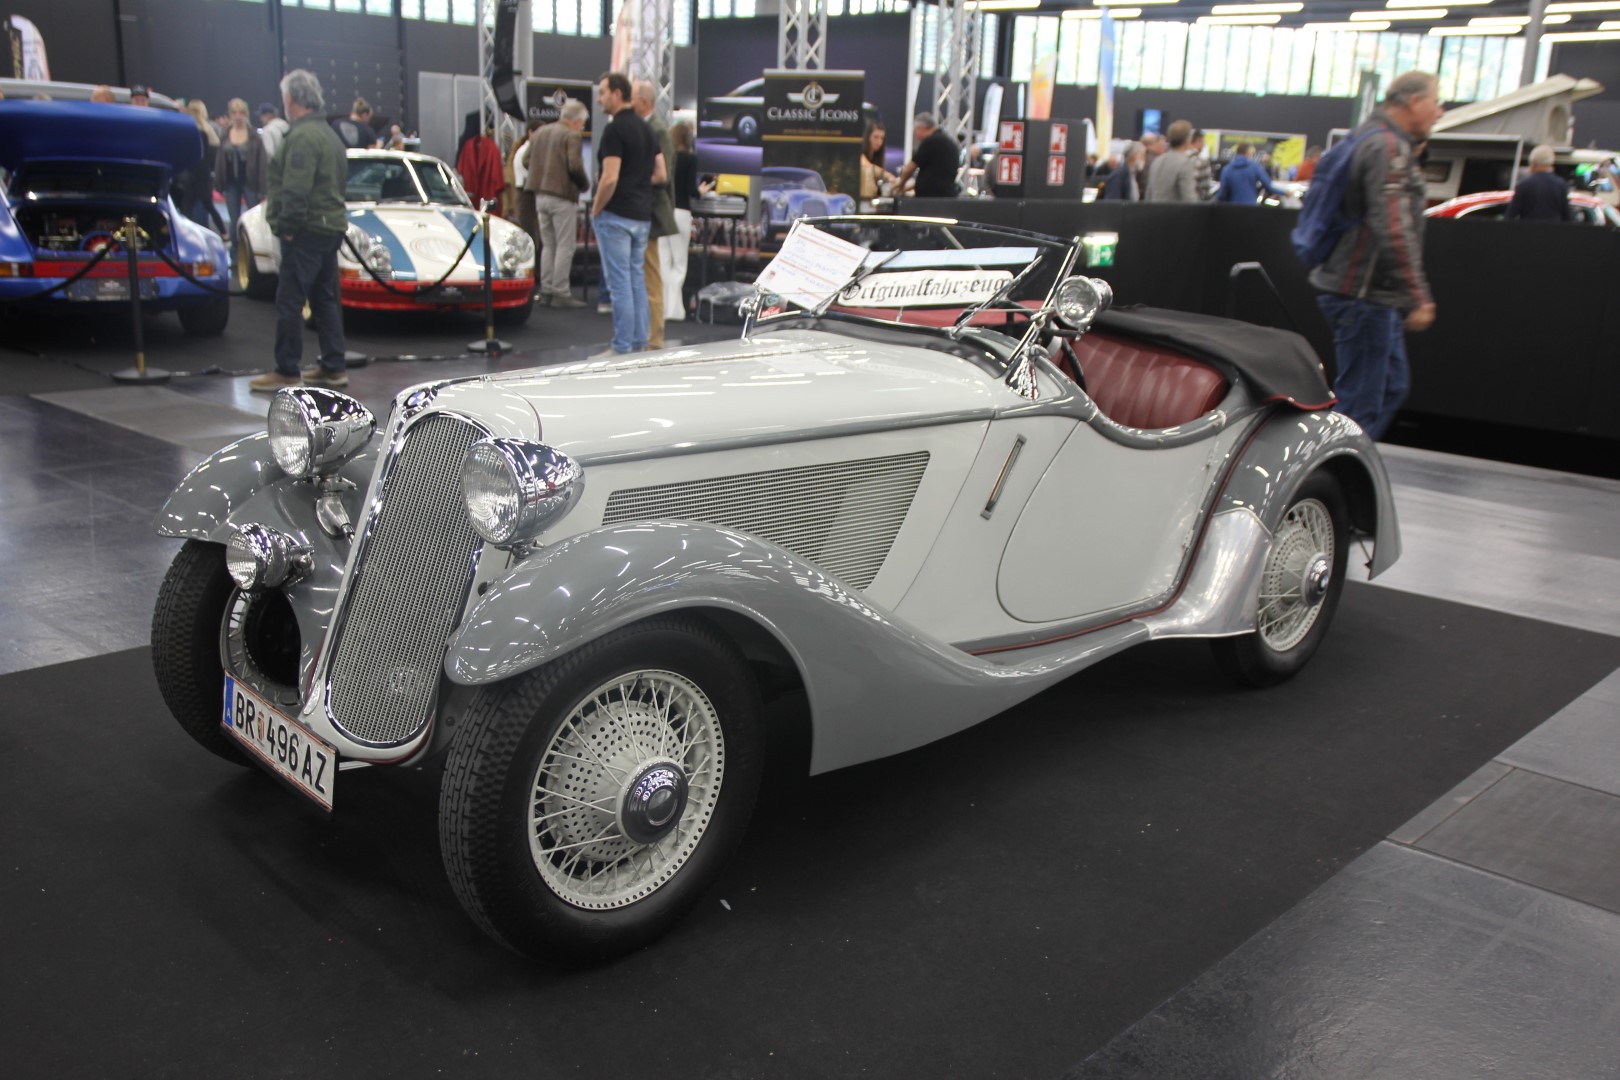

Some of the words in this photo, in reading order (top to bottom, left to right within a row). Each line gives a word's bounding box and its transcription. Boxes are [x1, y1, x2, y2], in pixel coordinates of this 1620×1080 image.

[767, 106, 817, 121] CLASSIC
[820, 107, 859, 122] ICONS
[842, 277, 1007, 302] Originalfahrzeug
[236, 691, 256, 740] BR
